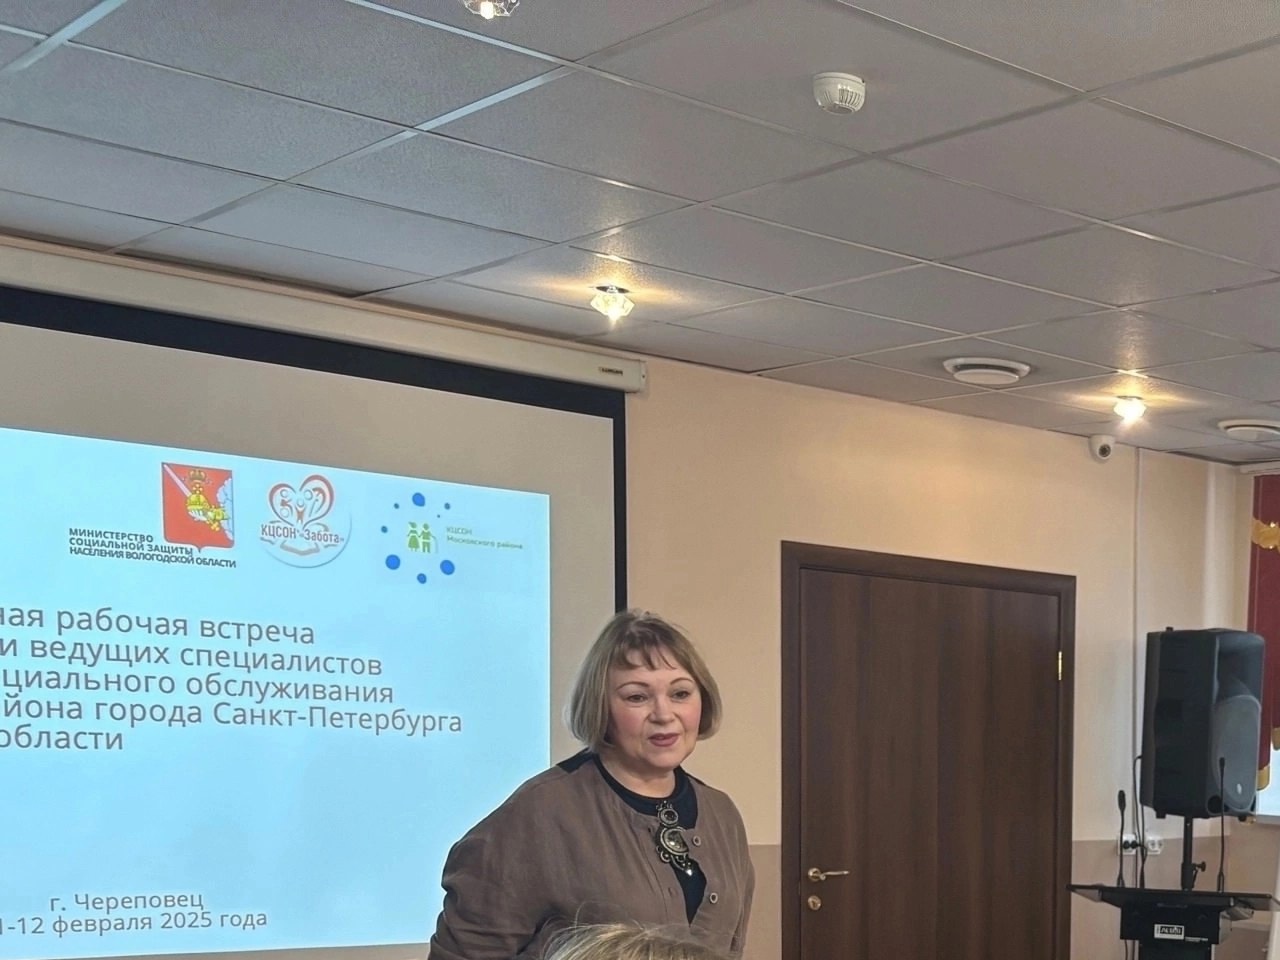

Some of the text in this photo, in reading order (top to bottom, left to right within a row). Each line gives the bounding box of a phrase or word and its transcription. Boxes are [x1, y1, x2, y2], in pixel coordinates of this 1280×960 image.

[69, 528, 154, 543] МИНИСТЕРСТВО
[261, 524, 297, 539] КЦСОН
[69, 537, 193, 556] СОЦИАЛЬНОЙ ЗАЩИТЫ
[70, 547, 236, 568] НАСЕЛЕНИЯ ВОЛОГОДСКОЙ ОБЛАСТИ
[57, 607, 188, 636] рабочая
[200, 619, 314, 647] встреча
[30, 639, 170, 668] ведущих
[180, 648, 382, 676] специалистов
[2, 669, 393, 703] циального обслуживания
[3, 692, 462, 737] йона города Санкт-Петербурга
[0, 723, 123, 750] области
[50, 893, 204, 915] г. Череповец
[52, 915, 152, 938] февраля
[160, 911, 212, 929] 2025
[220, 913, 267, 930] года
